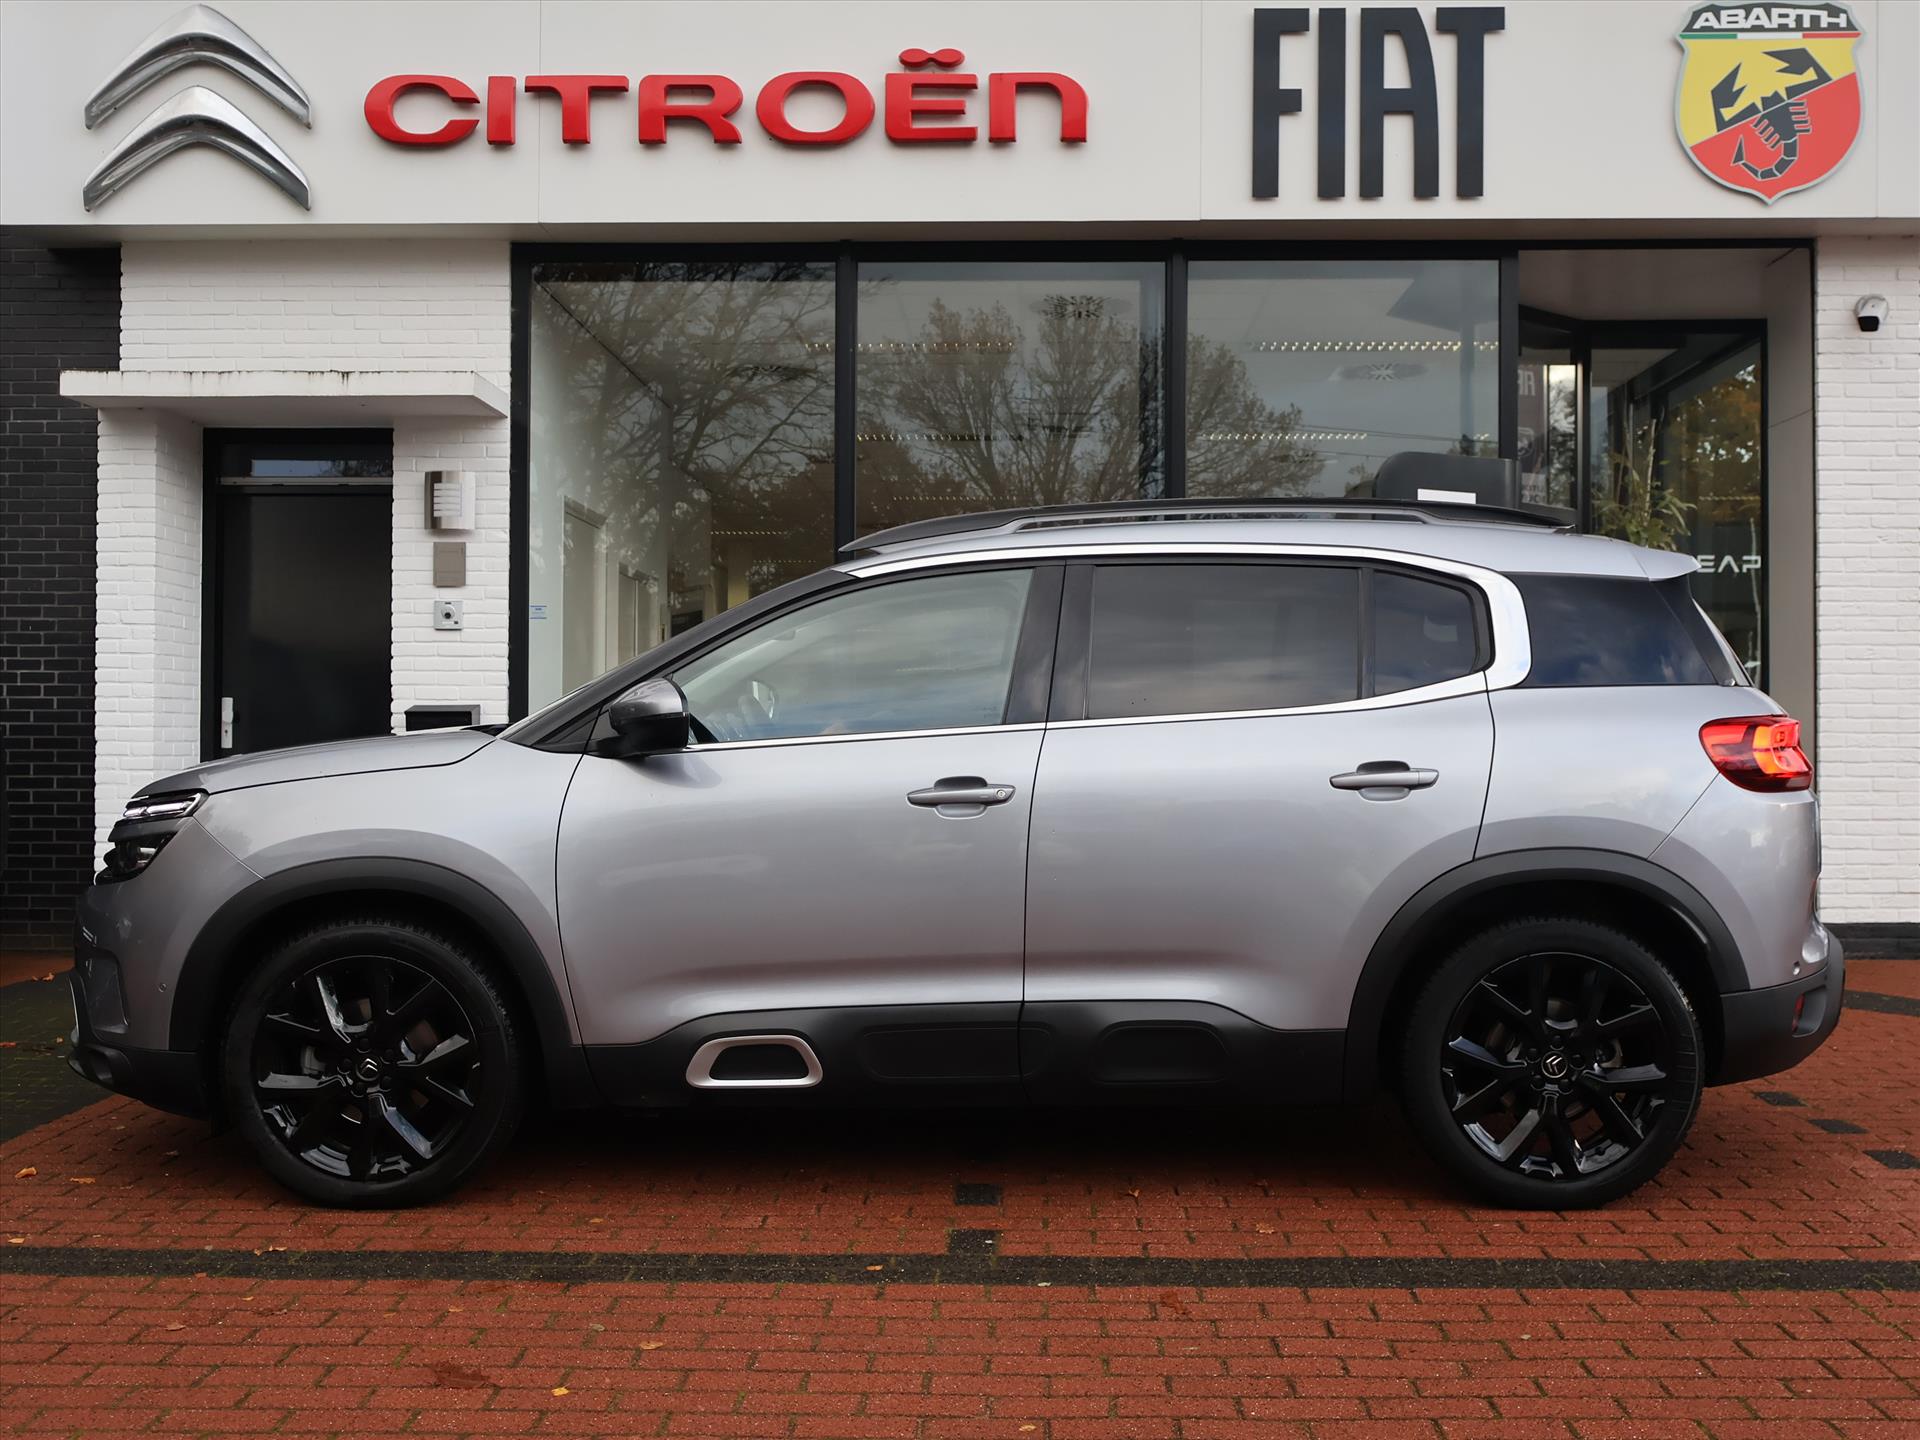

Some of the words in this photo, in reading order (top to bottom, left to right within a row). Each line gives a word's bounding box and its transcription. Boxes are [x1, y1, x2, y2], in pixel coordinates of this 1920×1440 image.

[1692, 7, 1847, 29] ABARTH
[364, 48, 1089, 146] CITROËN
[1252, 7, 1505, 198] FIAT
